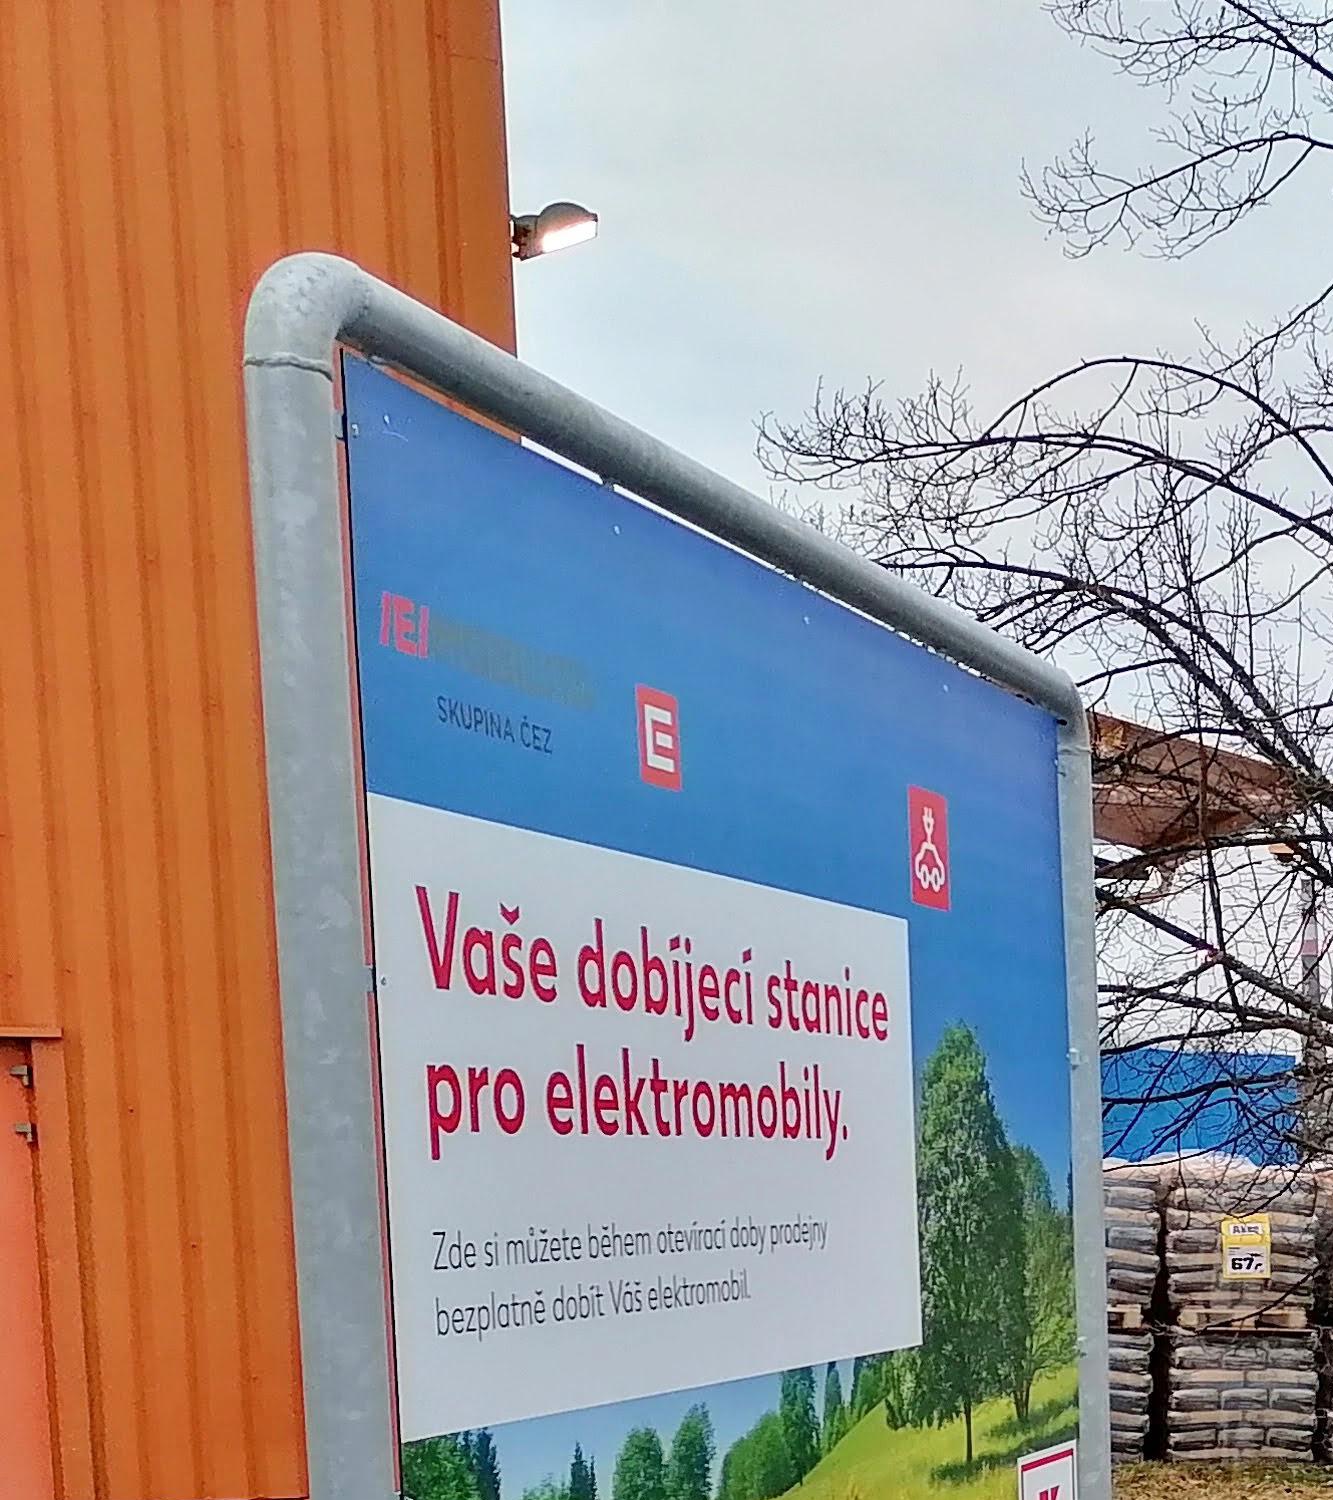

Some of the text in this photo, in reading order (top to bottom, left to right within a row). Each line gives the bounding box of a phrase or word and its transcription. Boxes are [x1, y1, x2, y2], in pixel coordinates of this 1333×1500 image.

[437, 696, 552, 754] SKUPINA ČEZ
[415, 885, 889, 1042] Vaše dobíjecí stanice
[426, 1045, 848, 1161] pro elektromobily.
[433, 1213, 829, 1270] Zde si můžete během otevírací doby prodejny
[435, 1269, 751, 1342] bezplatně dobít Váš elektromobil.
